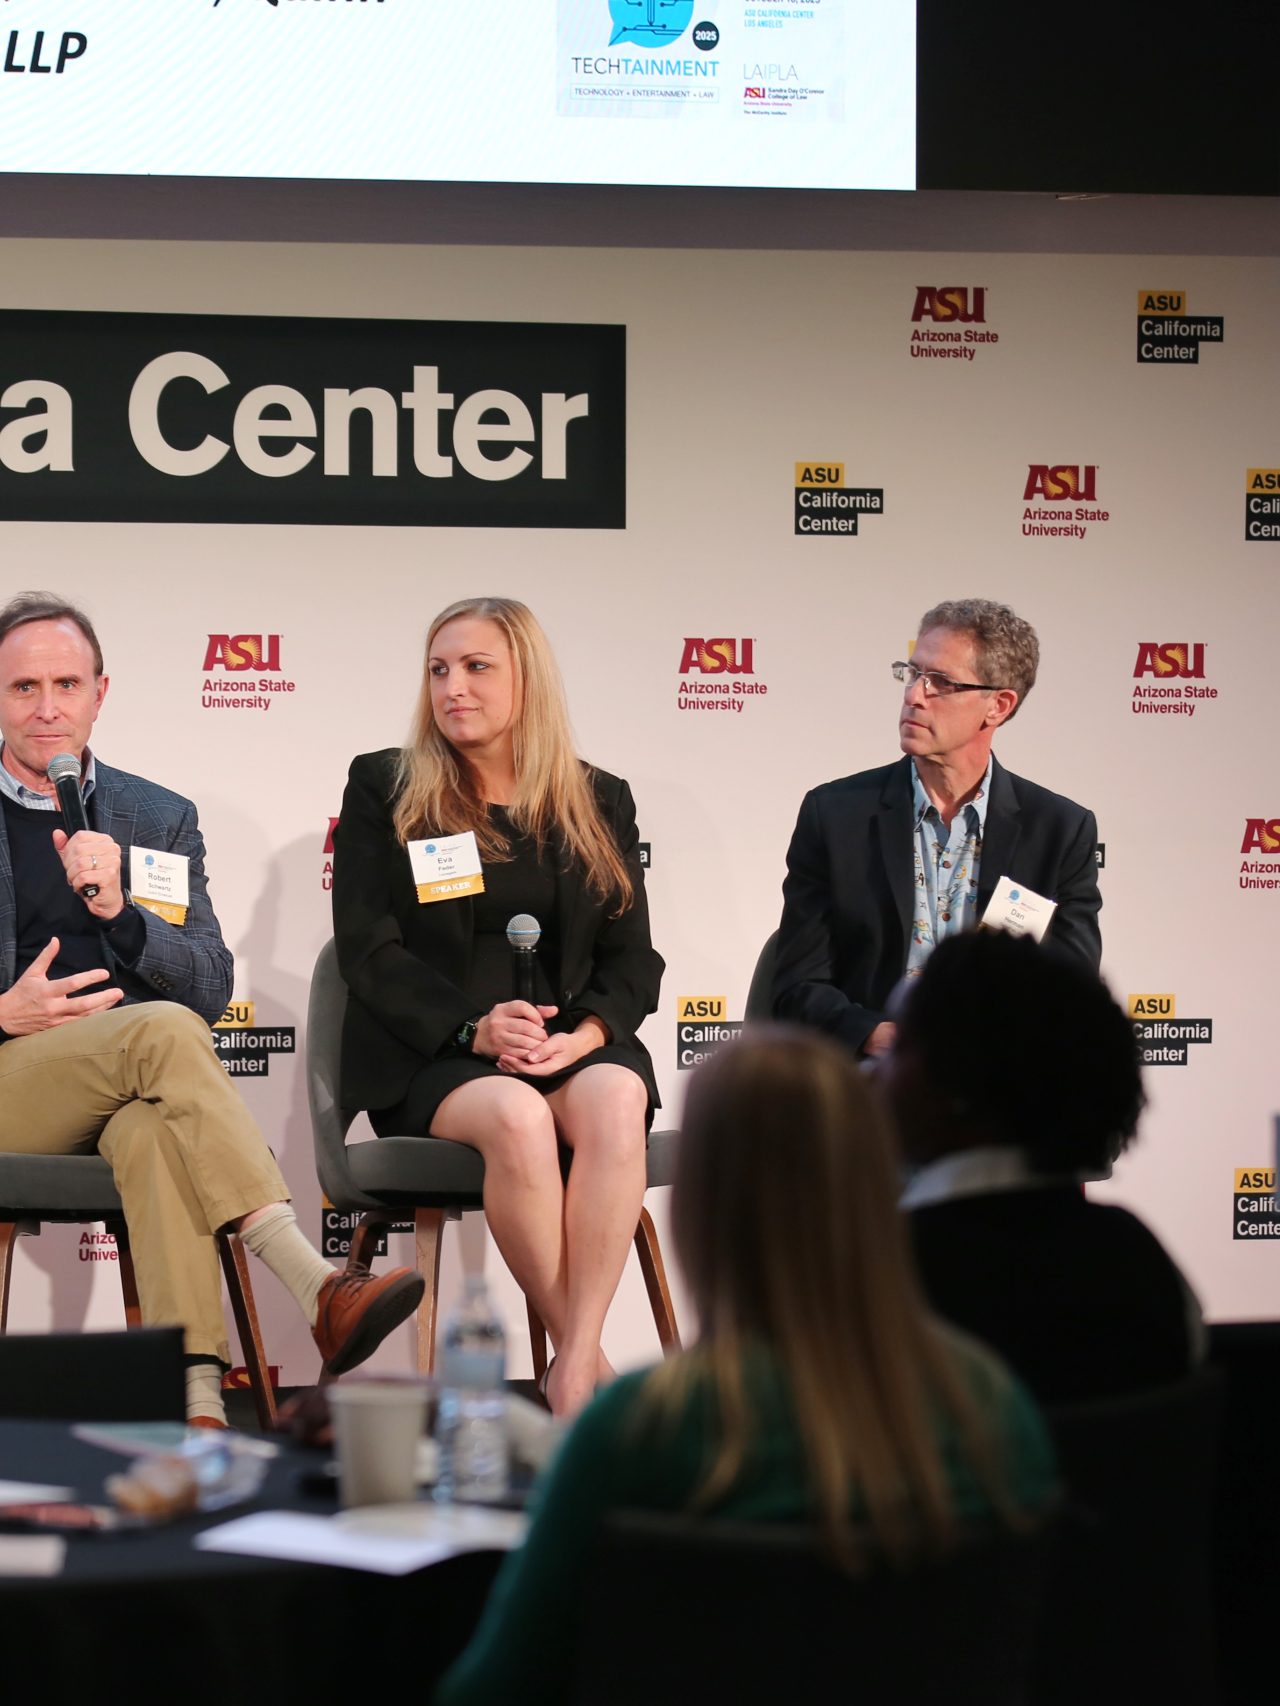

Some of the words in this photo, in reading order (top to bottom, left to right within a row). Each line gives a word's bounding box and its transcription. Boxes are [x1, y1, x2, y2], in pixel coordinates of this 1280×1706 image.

[695, 30, 717, 41] 2025
[4, 31, 88, 73] LLP
[571, 57, 719, 77] TECHTAINMENT
[744, 64, 798, 80] LAIPLA
[574, 88, 624, 96] TECHNOLOGY
[632, 90, 690, 98] ENTERTAINMENT
[911, 286, 986, 323] ASU
[1144, 295, 1181, 311] ASU
[911, 329, 962, 342] Arizona
[964, 330, 999, 343] State
[1141, 320, 1220, 336] California
[910, 345, 976, 361] University
[1141, 343, 1196, 359] Center
[129, 350, 589, 482] Center
[801, 467, 839, 483] ASU
[1023, 465, 1097, 501] ASU
[1252, 473, 1280, 489] AS
[799, 492, 880, 508] California
[1023, 507, 1072, 520] Arizona
[1075, 508, 1109, 521] State
[799, 515, 855, 531] Center
[1022, 523, 1087, 539] University
[1249, 521, 1280, 537] Cen
[202, 635, 282, 671] ASU
[679, 638, 754, 674] ASU
[1133, 643, 1206, 679] ASU
[202, 679, 256, 692] Arizona
[258, 679, 296, 692] State
[678, 681, 730, 694] Arizona
[732, 682, 768, 695] State
[1133, 685, 1182, 698] Arizona
[1184, 686, 1218, 698] State
[202, 696, 271, 711] University
[678, 698, 744, 713] University
[1132, 701, 1196, 717] University
[1240, 818, 1280, 853] AS
[1240, 861, 1280, 873] Arizon
[148, 873, 171, 883] Robert
[1240, 877, 1280, 889] Univer
[430, 881, 472, 895] SPEAKER
[1011, 908, 1025, 921] Dan
[221, 1007, 248, 1022] SU
[683, 1001, 722, 1017] ASU
[1134, 999, 1170, 1014] ASU
[681, 1026, 742, 1042] Califor
[1143, 1047, 1185, 1061] enter
[221, 1058, 265, 1072] enter
[1240, 1173, 1276, 1188] ASU
[1237, 1220, 1280, 1236] Cente
[79, 1248, 118, 1262] Unive
